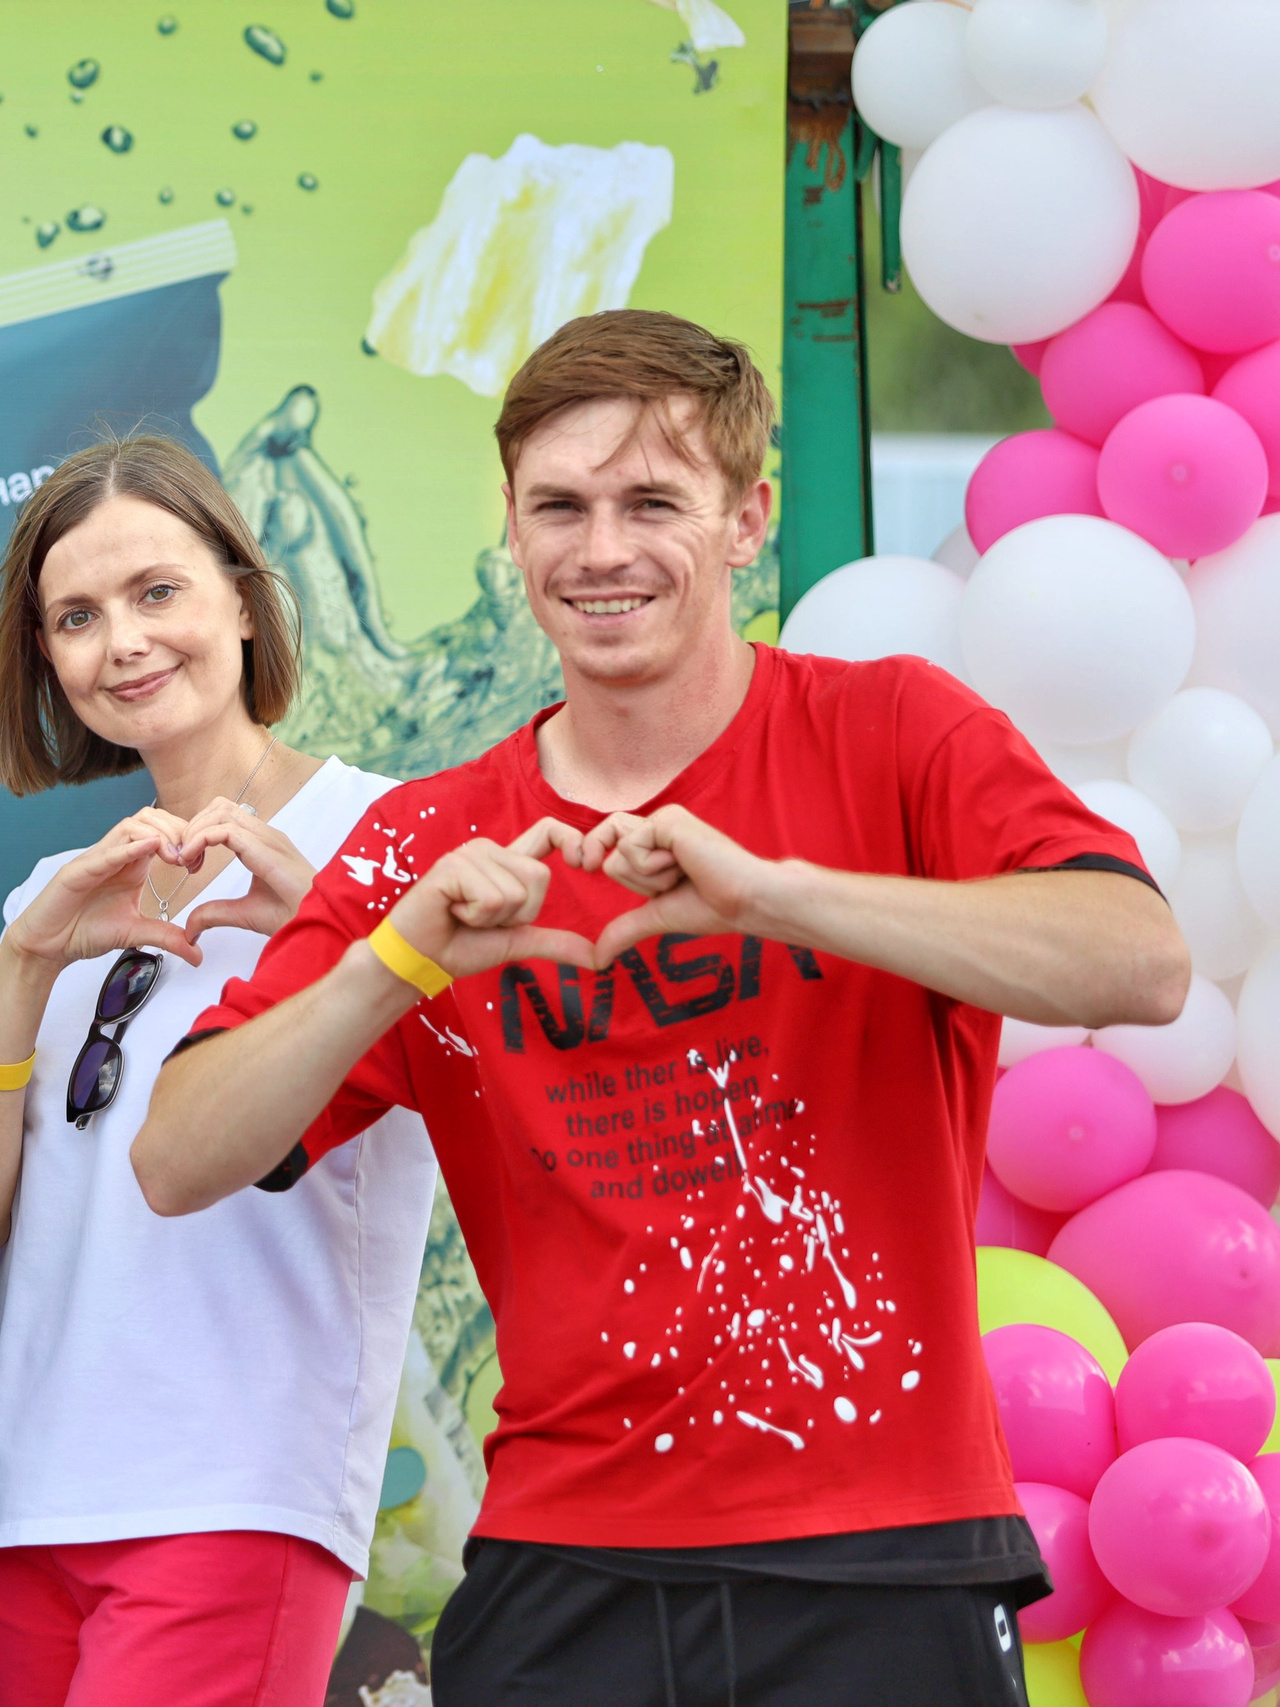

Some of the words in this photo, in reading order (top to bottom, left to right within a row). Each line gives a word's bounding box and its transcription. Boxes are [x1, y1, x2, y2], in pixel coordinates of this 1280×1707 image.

[545, 1072, 616, 1104] while
[625, 1061, 677, 1092] ther
[687, 1051, 709, 1076] is
[566, 1108, 635, 1138] there
[644, 1098, 666, 1124] is
[675, 1075, 759, 1117] hopen
[567, 1148, 619, 1169] one
[627, 1130, 696, 1166] thing
[591, 1174, 643, 1199] and
